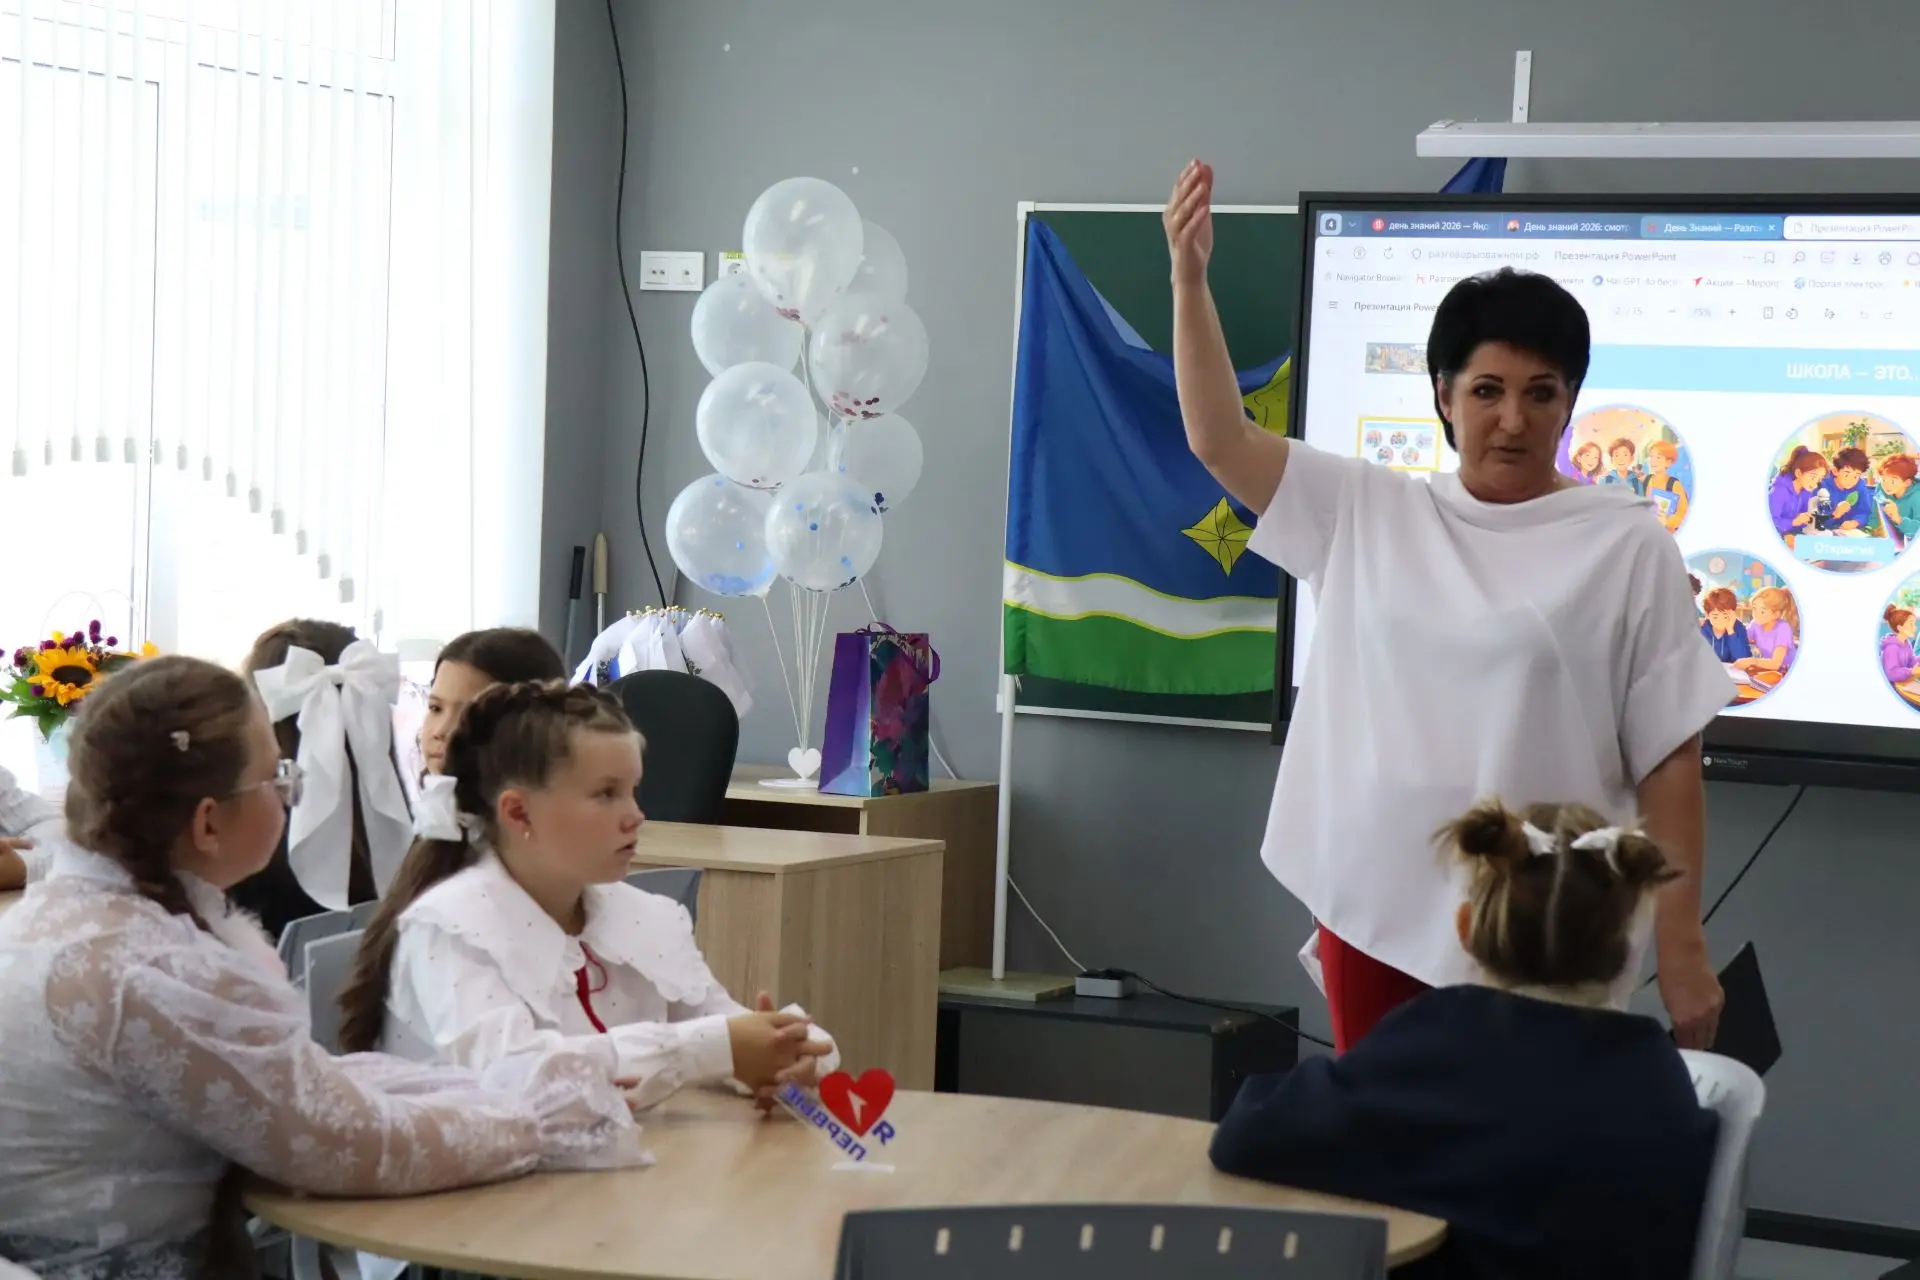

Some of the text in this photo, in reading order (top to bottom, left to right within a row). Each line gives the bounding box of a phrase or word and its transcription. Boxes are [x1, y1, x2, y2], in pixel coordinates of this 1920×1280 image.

[1388, 222, 1409, 231] день
[1410, 221, 1440, 230] знаний
[1441, 222, 1461, 230] 2026
[1524, 222, 1546, 232] День
[1547, 221, 1579, 232] знаний
[1579, 222, 1603, 232] 2026:
[1664, 223, 1687, 233] День
[1688, 222, 1722, 232] Знаний
[1810, 223, 1871, 234] Презентация
[1554, 251, 1676, 261] Презентация PowerPoint
[1336, 273, 1374, 283] Navigator
[1354, 302, 1411, 313] Презентация
[1786, 362, 1851, 381] ШКОЛА
